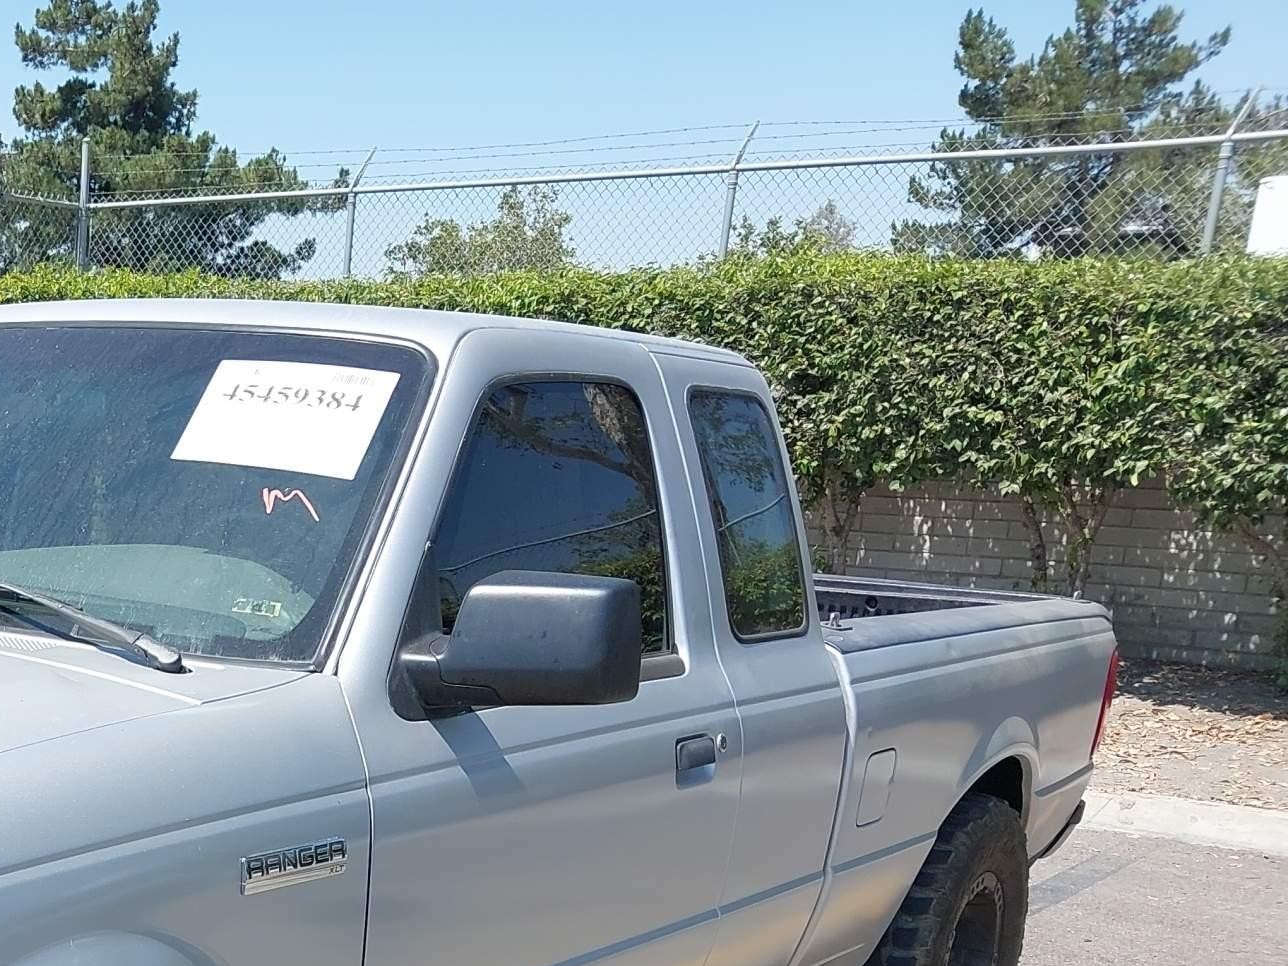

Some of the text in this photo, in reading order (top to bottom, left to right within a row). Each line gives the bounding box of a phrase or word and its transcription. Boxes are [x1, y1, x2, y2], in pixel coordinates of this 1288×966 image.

[223, 382, 364, 412] 45459384
[246, 840, 346, 879] RANGER
[328, 864, 346, 875] XLT
